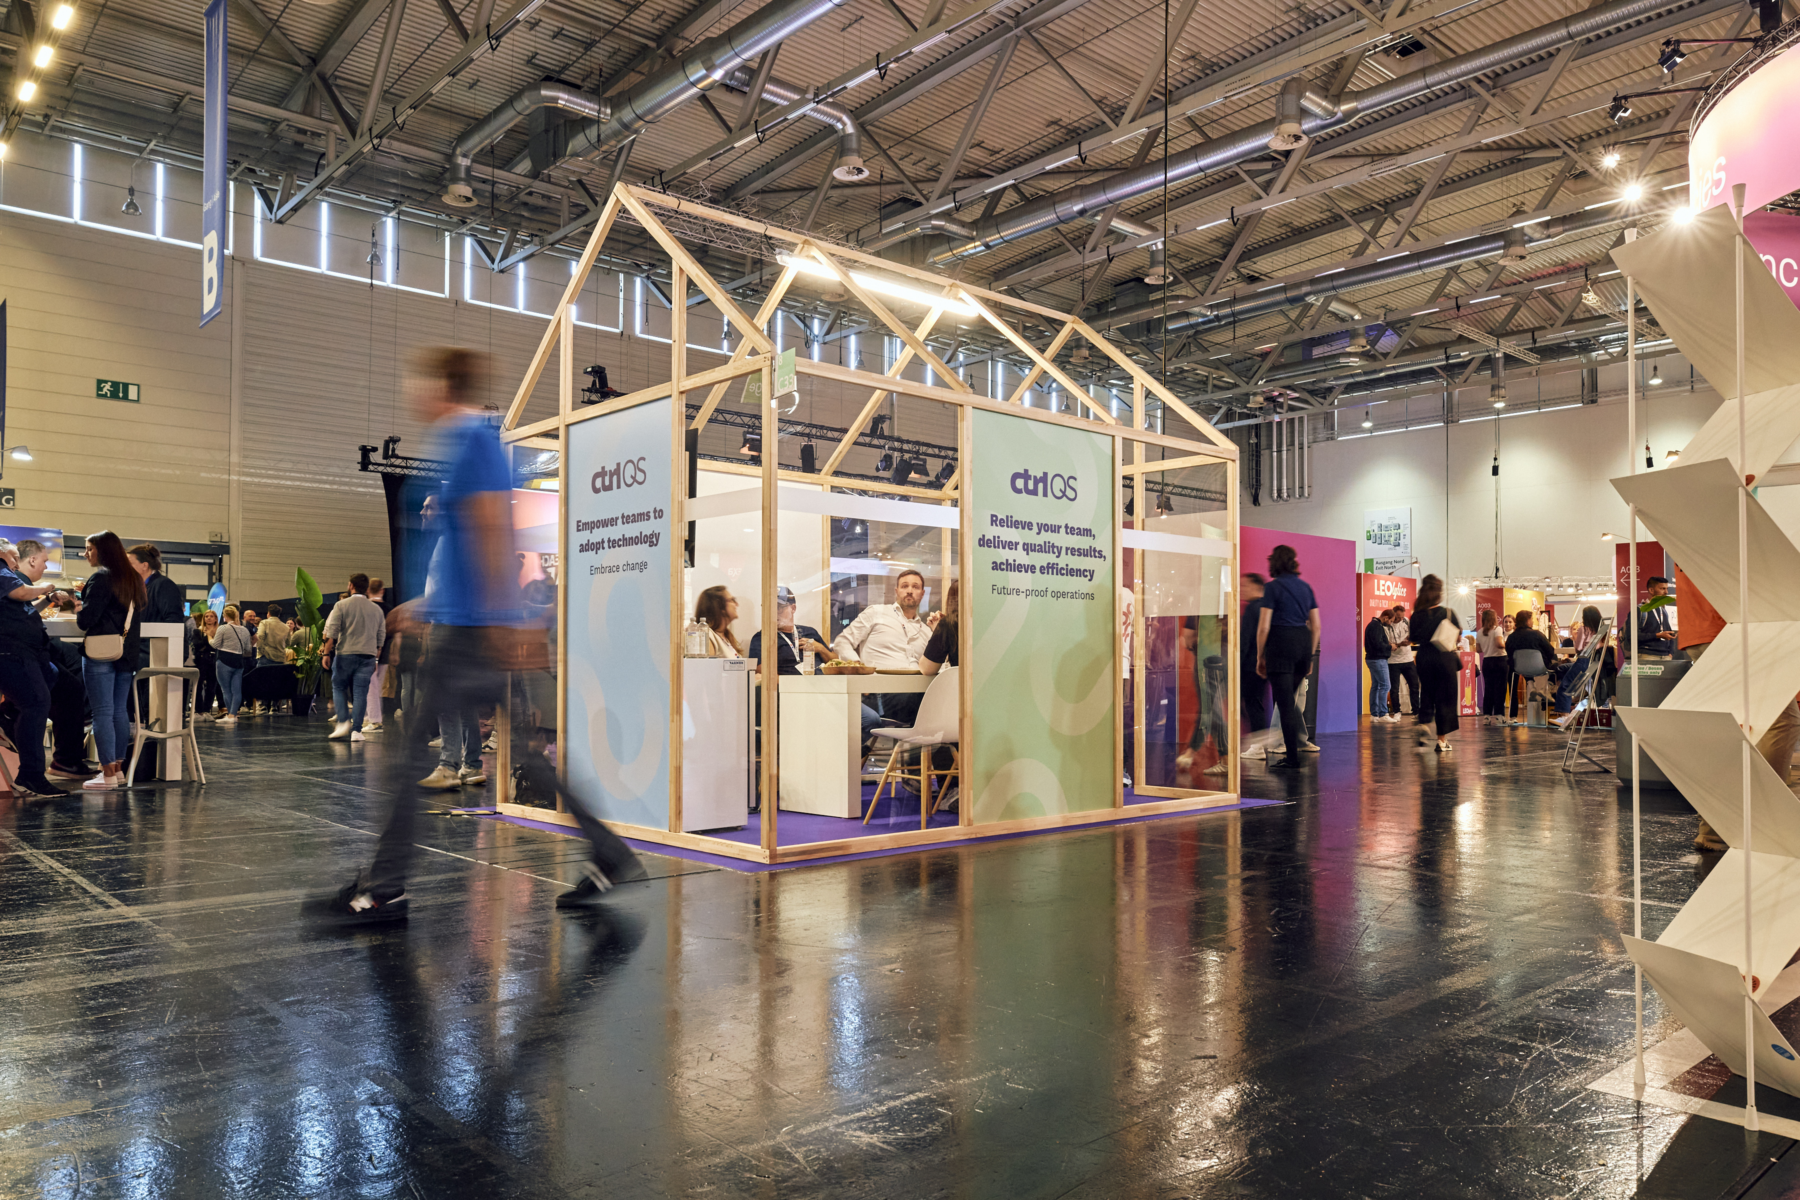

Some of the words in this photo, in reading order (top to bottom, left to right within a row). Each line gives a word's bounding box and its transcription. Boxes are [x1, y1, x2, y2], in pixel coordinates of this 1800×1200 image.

[203, 229, 218, 315] B
[778, 373, 794, 391] C33
[576, 515, 619, 534] Empower
[621, 510, 651, 525] teams
[653, 507, 664, 520] to
[990, 513, 1033, 531] Relieve
[1036, 521, 1062, 535] your
[1064, 523, 1096, 540] team,
[579, 537, 605, 554] adopt
[607, 530, 661, 550] technology
[978, 534, 1020, 551] deliver
[1022, 541, 1063, 558] quality
[1065, 545, 1106, 561] results,
[589, 564, 620, 576] Embrace
[622, 560, 648, 573] change
[991, 559, 1037, 574] achieve
[1039, 562, 1095, 582] efficiency
[991, 584, 1049, 599] Future-proof
[1051, 589, 1095, 601] operations
